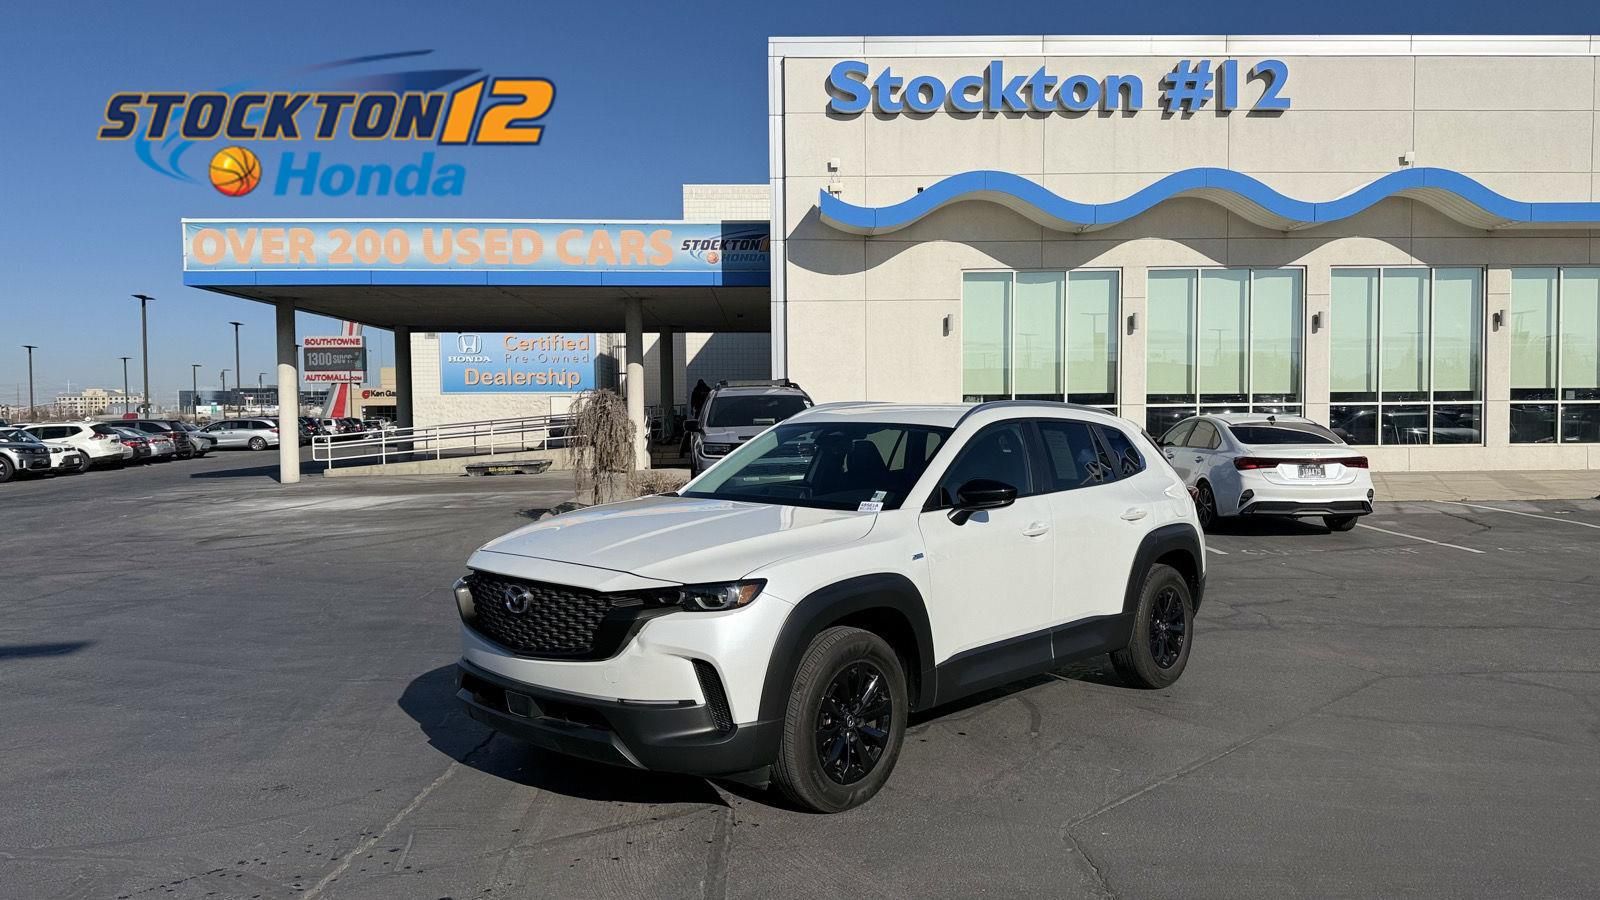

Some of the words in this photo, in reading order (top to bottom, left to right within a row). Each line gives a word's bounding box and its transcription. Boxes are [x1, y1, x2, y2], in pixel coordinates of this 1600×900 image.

[829, 61, 1143, 114] Stockton
[1164, 59, 1291, 113] #12
[192, 228, 317, 265] OVER
[328, 228, 411, 265] 200
[423, 228, 544, 265] USED
[555, 228, 673, 265] CARS
[681, 239, 760, 251] STOCKTON
[304, 338, 361, 346] SOUTHTOWNE
[503, 334, 590, 351] Certified
[306, 352, 332, 366] 1300
[448, 355, 492, 363] HONDA
[505, 353, 590, 364] Pre-Owned
[464, 368, 581, 390] Dealership
[370, 389, 385, 397] Ken
